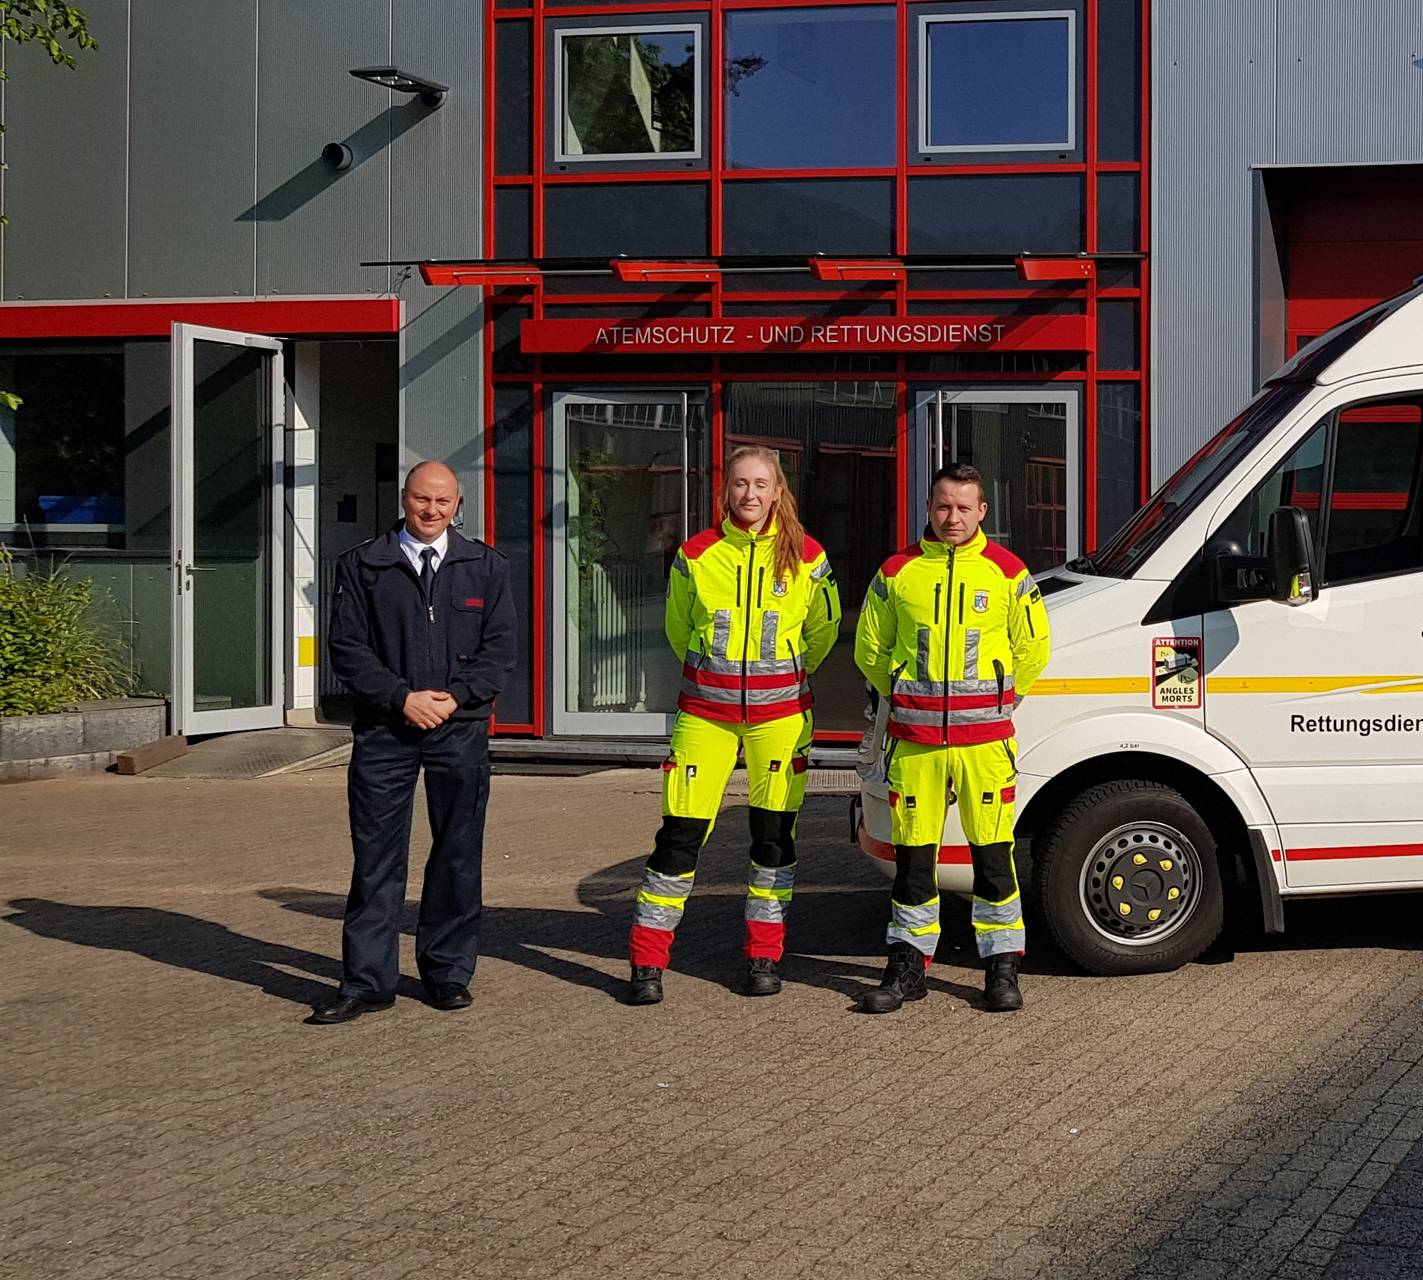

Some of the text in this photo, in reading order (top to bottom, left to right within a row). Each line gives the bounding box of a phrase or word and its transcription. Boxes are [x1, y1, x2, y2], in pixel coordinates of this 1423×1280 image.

[595, 325, 735, 344] ATEMSCHUTZ
[760, 325, 804, 343] UND
[811, 324, 1006, 343] RETTUNGSDIENST
[1160, 687, 1194, 695] ANGLES
[1161, 695, 1193, 703] MORTS
